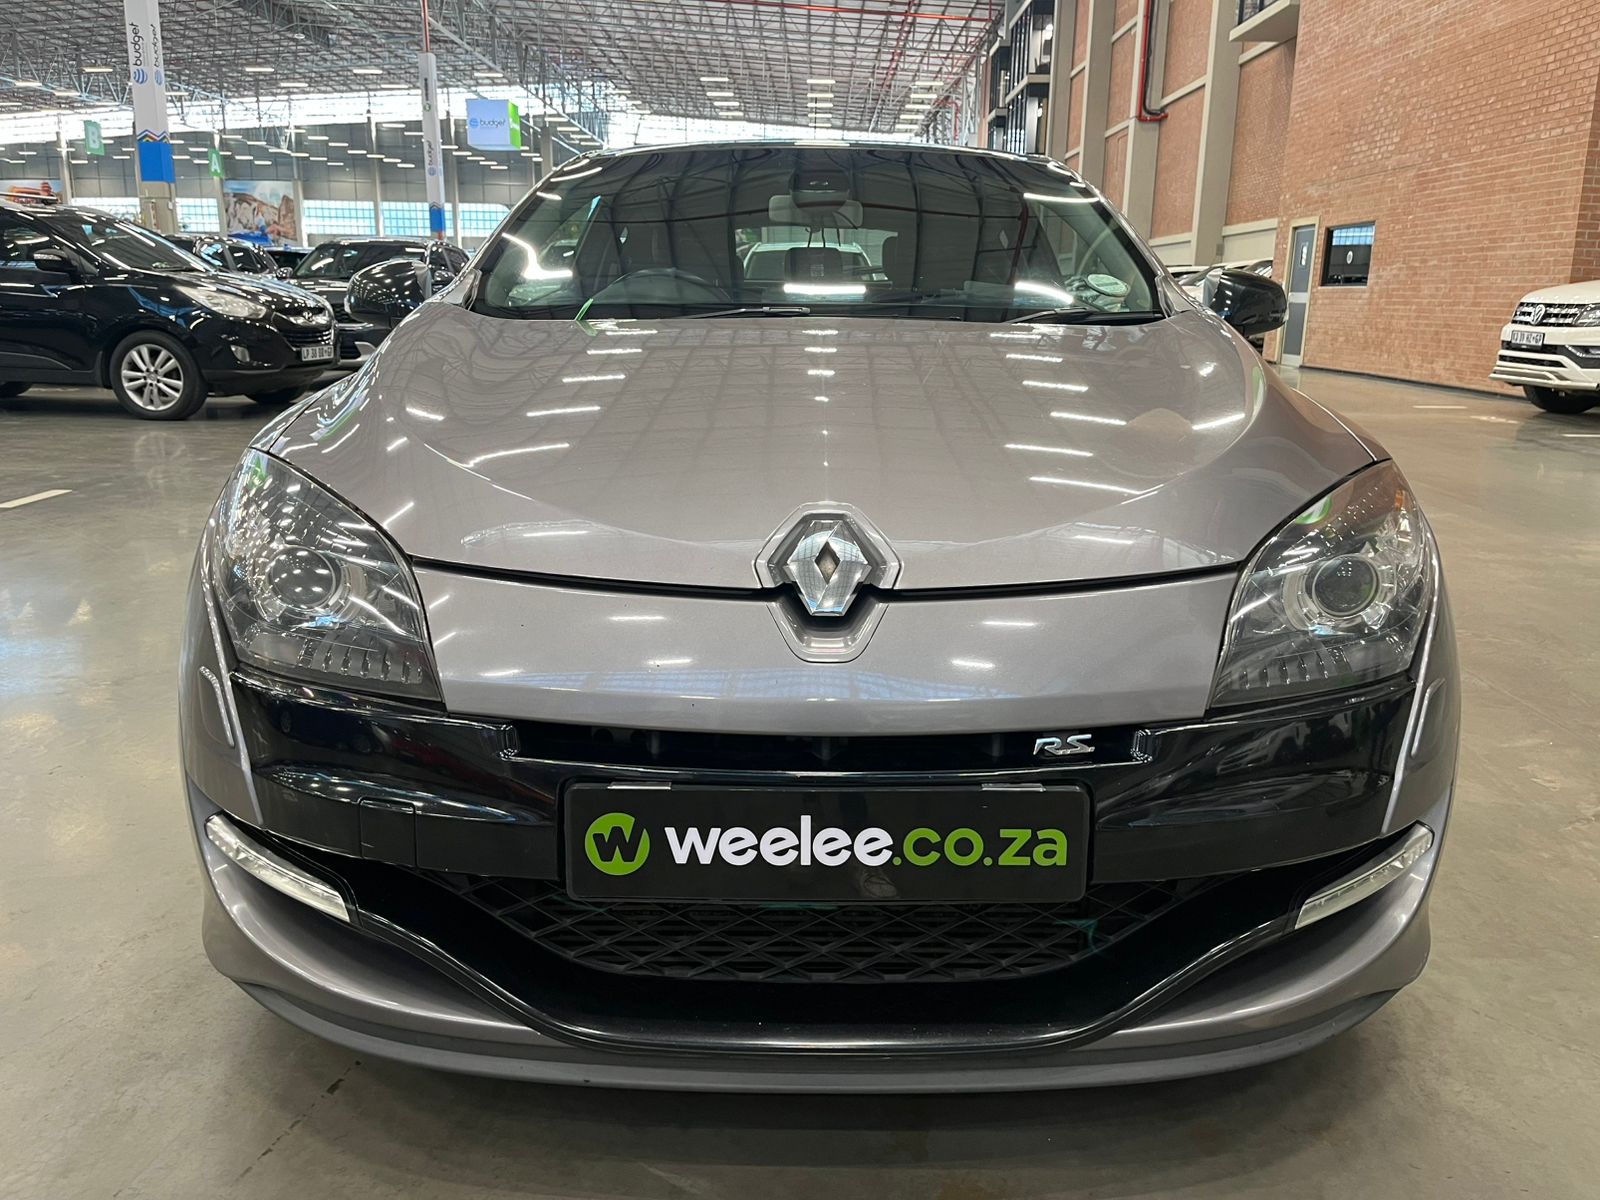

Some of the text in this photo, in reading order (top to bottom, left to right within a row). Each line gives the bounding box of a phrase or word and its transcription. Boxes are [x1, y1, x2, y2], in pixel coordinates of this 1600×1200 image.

[128, 22, 144, 67] budget
[480, 118, 506, 128] budget
[211, 153, 221, 173] A
[663, 814, 1069, 867] weelee.co.za
